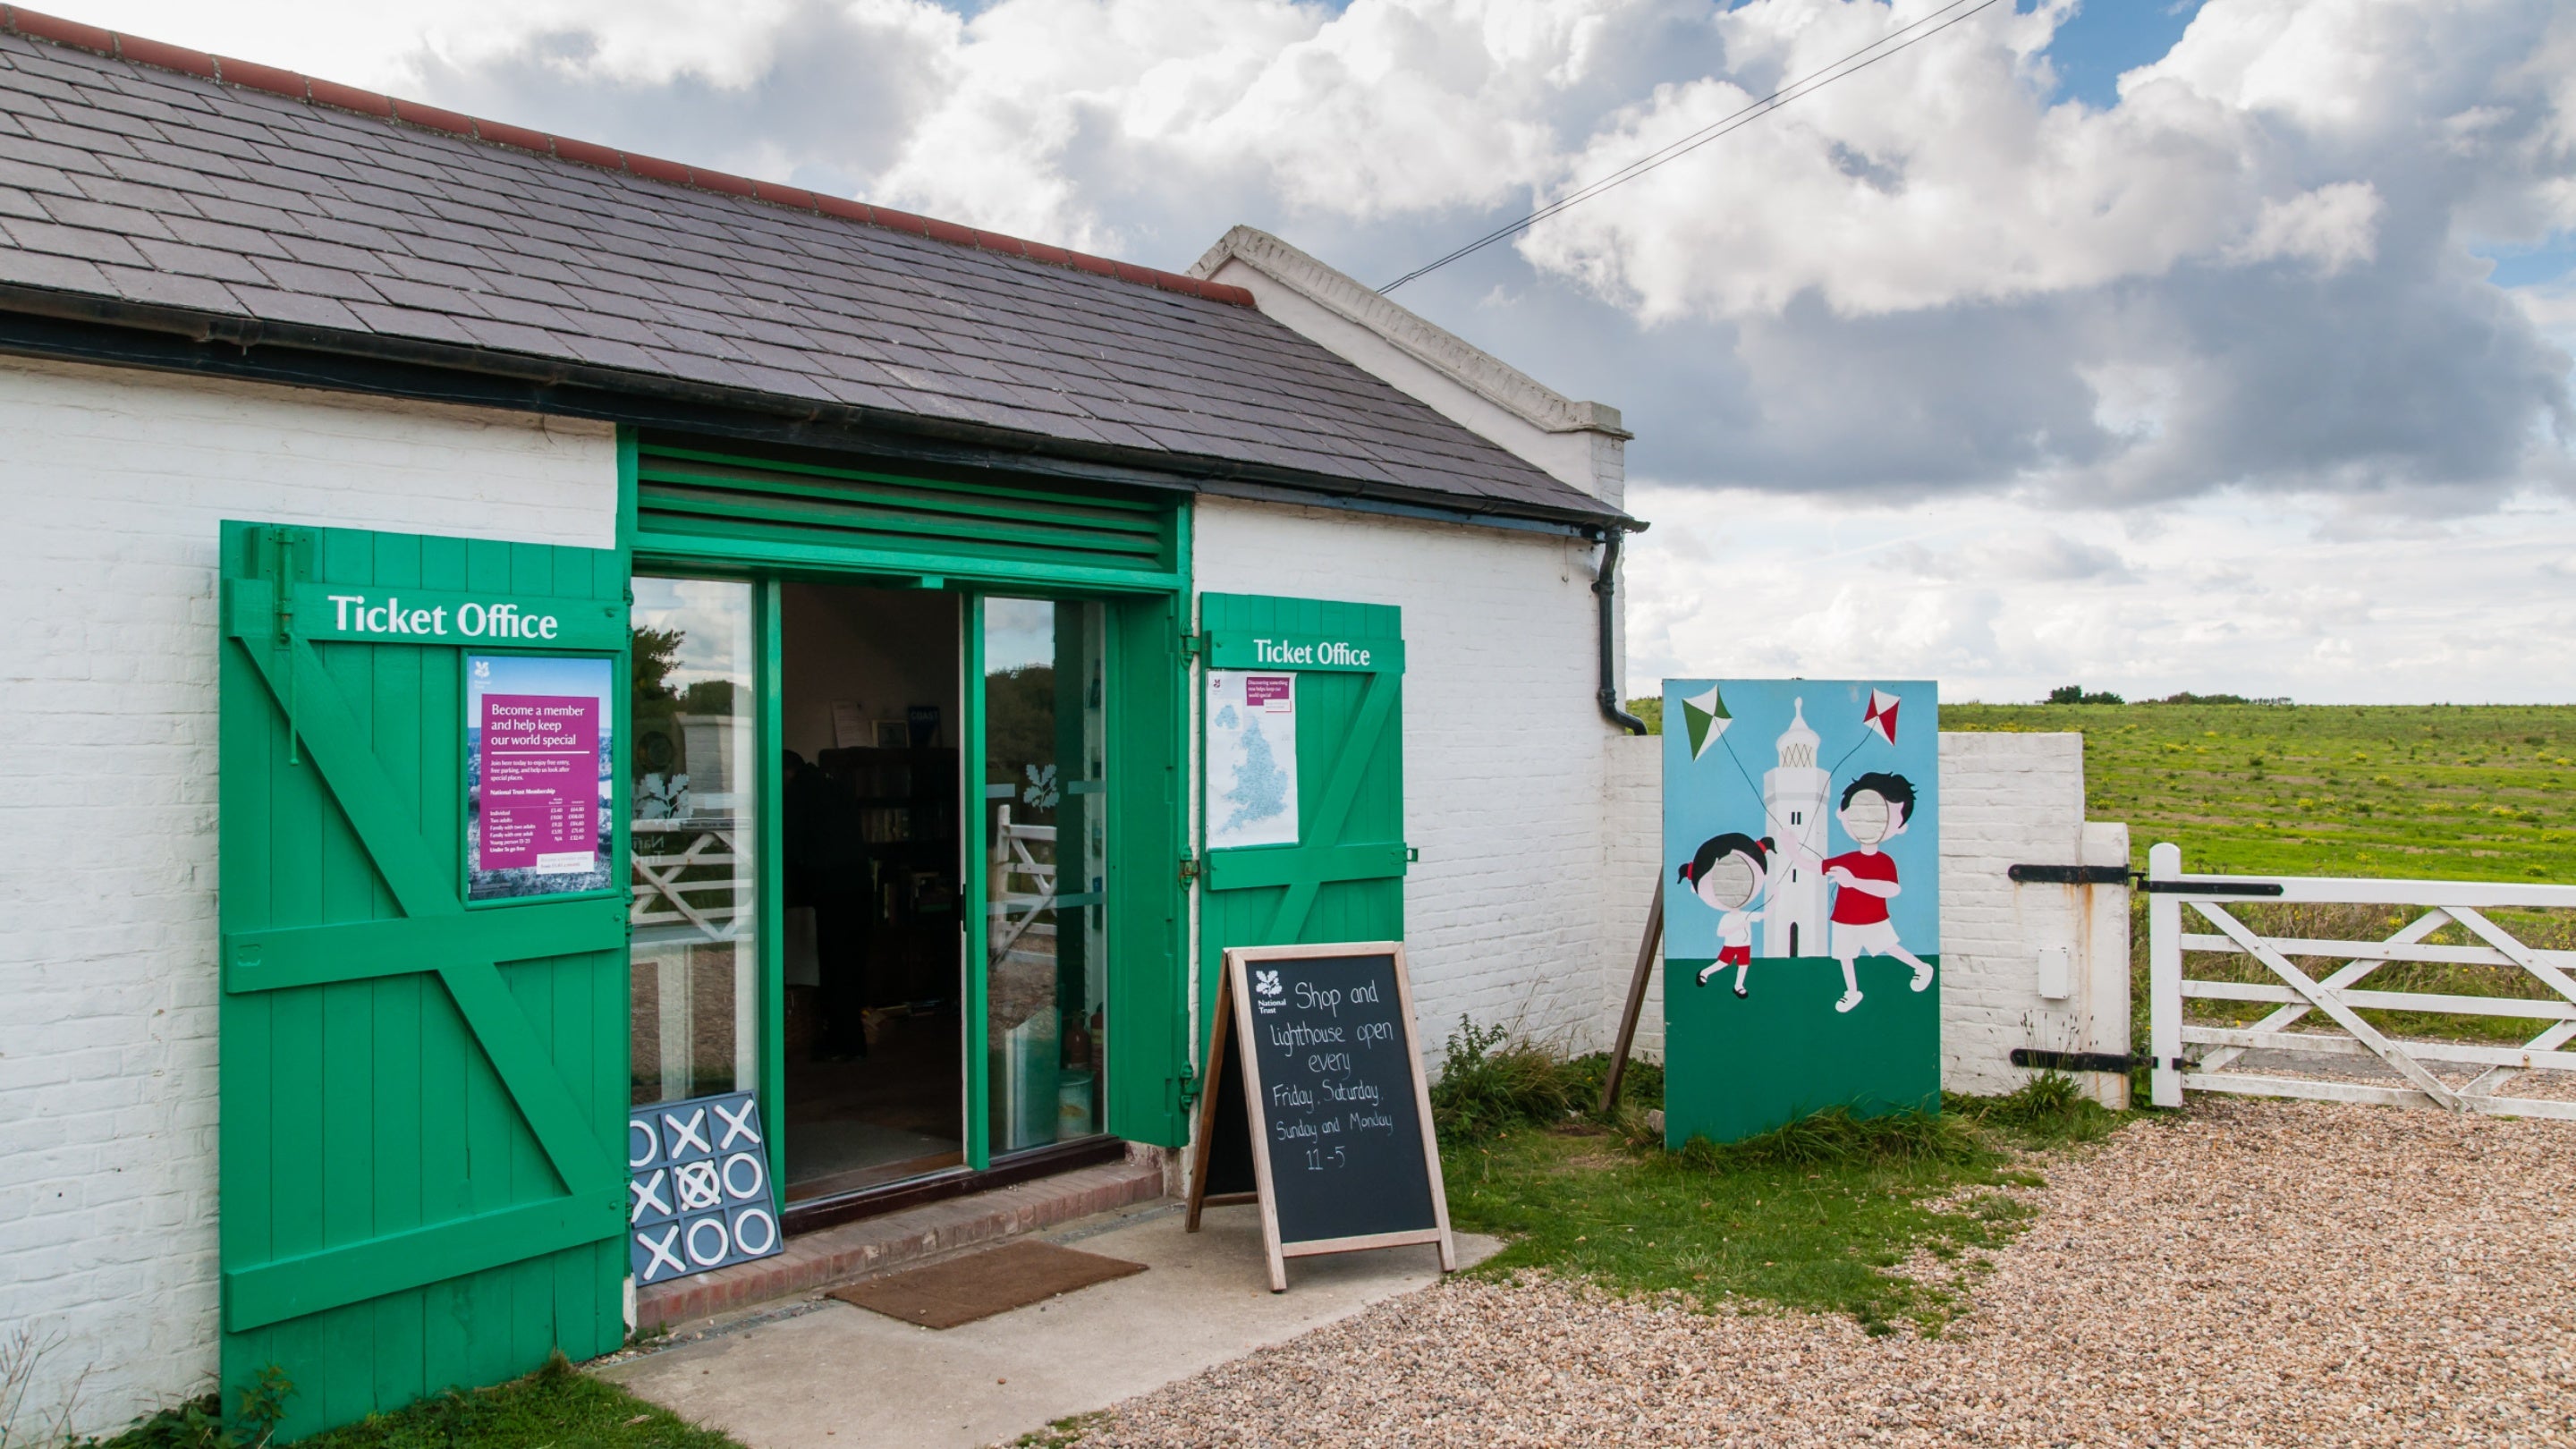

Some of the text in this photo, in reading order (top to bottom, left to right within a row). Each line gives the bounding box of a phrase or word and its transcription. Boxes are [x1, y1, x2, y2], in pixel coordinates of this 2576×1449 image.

[327, 595, 558, 640] Ticket Office
[1253, 639, 1370, 665] Ticket Office
[491, 704, 585, 716] Become a member
[491, 719, 562, 733] and help keep
[491, 734, 576, 748] our world special
[1258, 999, 1287, 1007] National
[1295, 979, 1380, 1018] Shop and
[1270, 1020, 1393, 1057] Lighthouse open
[1308, 1052, 1351, 1080] every
[1276, 1112, 1393, 1144] Sunday and Monday
